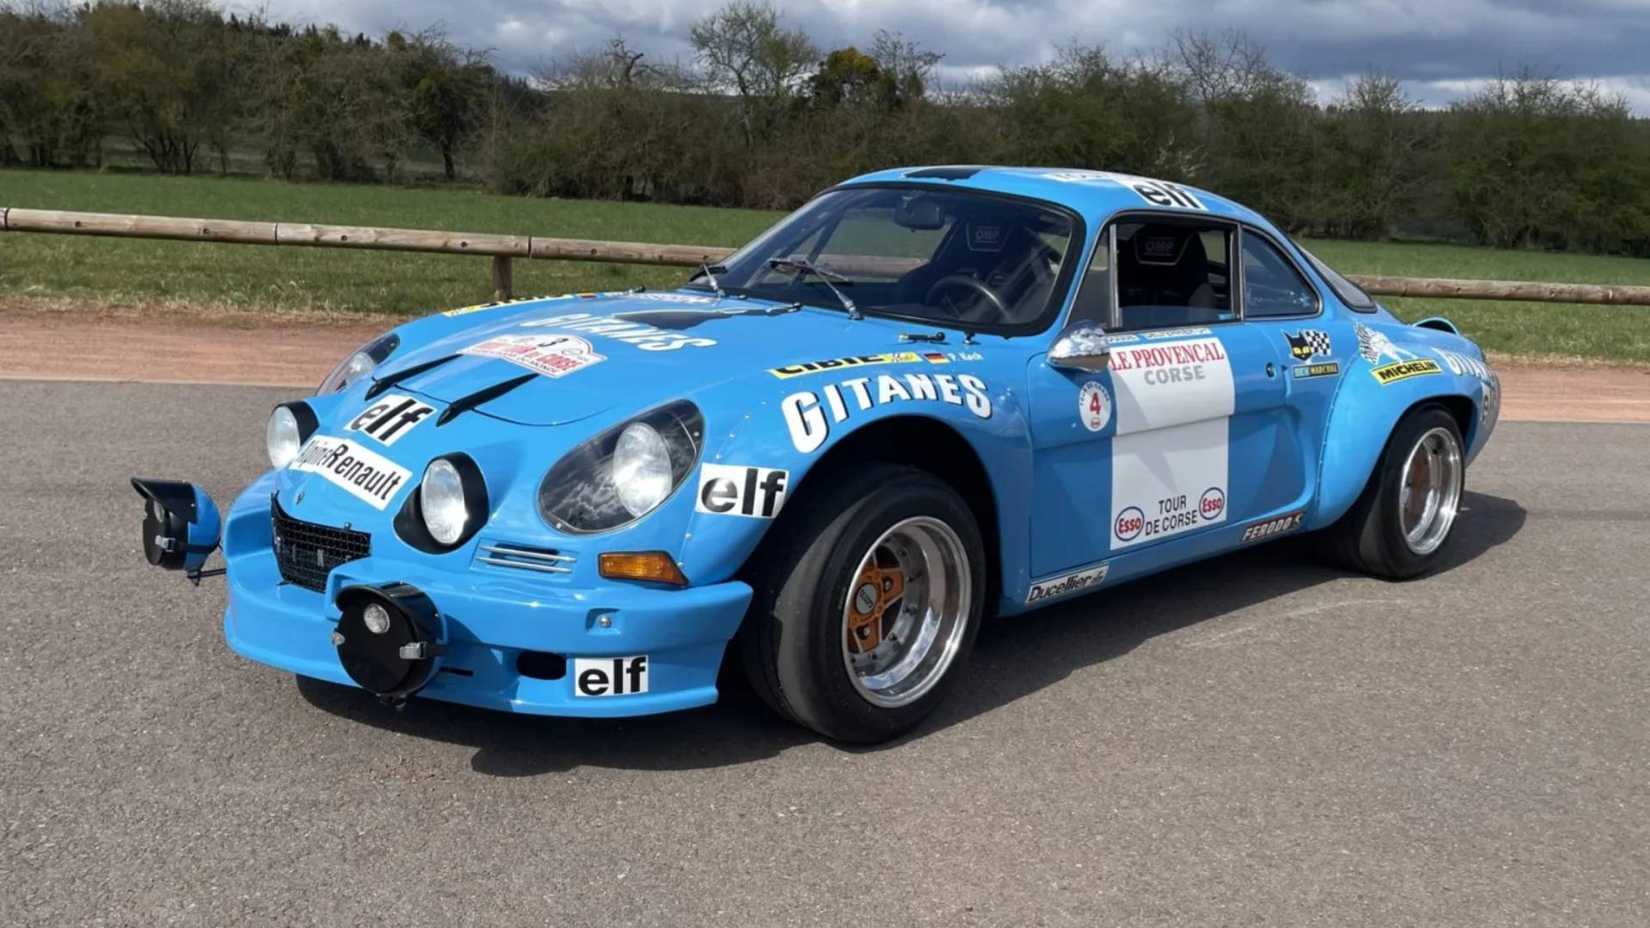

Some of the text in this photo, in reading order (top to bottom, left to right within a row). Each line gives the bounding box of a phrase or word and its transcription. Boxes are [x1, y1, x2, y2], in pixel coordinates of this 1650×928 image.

[1132, 180, 1200, 208] elf
[1110, 350, 1132, 371] LE
[1378, 359, 1439, 381] MICHELIN
[1143, 365, 1207, 386] CORSE
[780, 373, 993, 454] GITANES
[1089, 391, 1102, 416] 4
[350, 398, 435, 442] elf
[700, 467, 787, 518] elf
[1158, 495, 1187, 514] TOUR
[1145, 518, 1160, 536] DE
[1162, 509, 1198, 532] CORSE
[1028, 573, 1092, 602] Ducellier
[578, 656, 647, 696] elf
